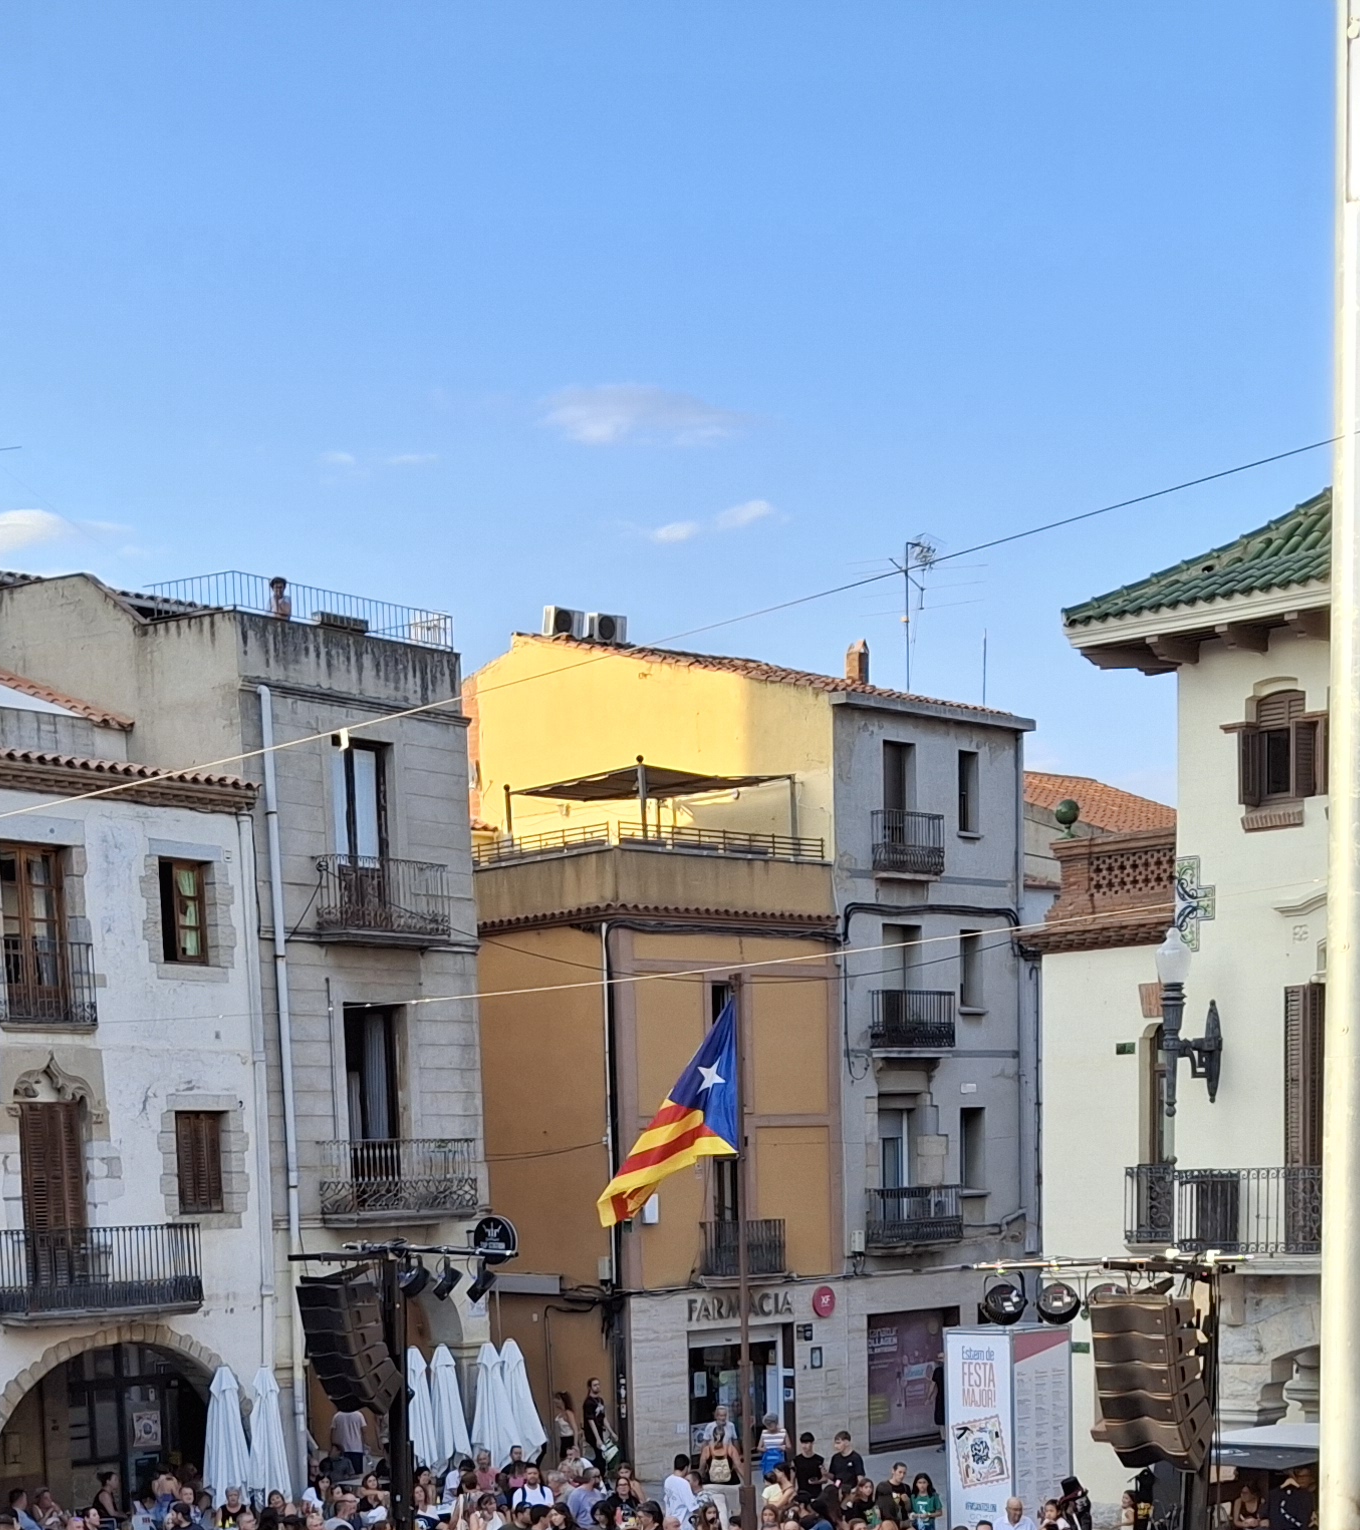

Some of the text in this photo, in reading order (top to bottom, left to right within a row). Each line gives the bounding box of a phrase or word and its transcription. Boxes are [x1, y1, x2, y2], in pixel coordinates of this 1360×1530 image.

[962, 1345, 994, 1361] Estem de
[961, 1362, 996, 1388] FESTA
[962, 1388, 996, 1408] MAJOR!
